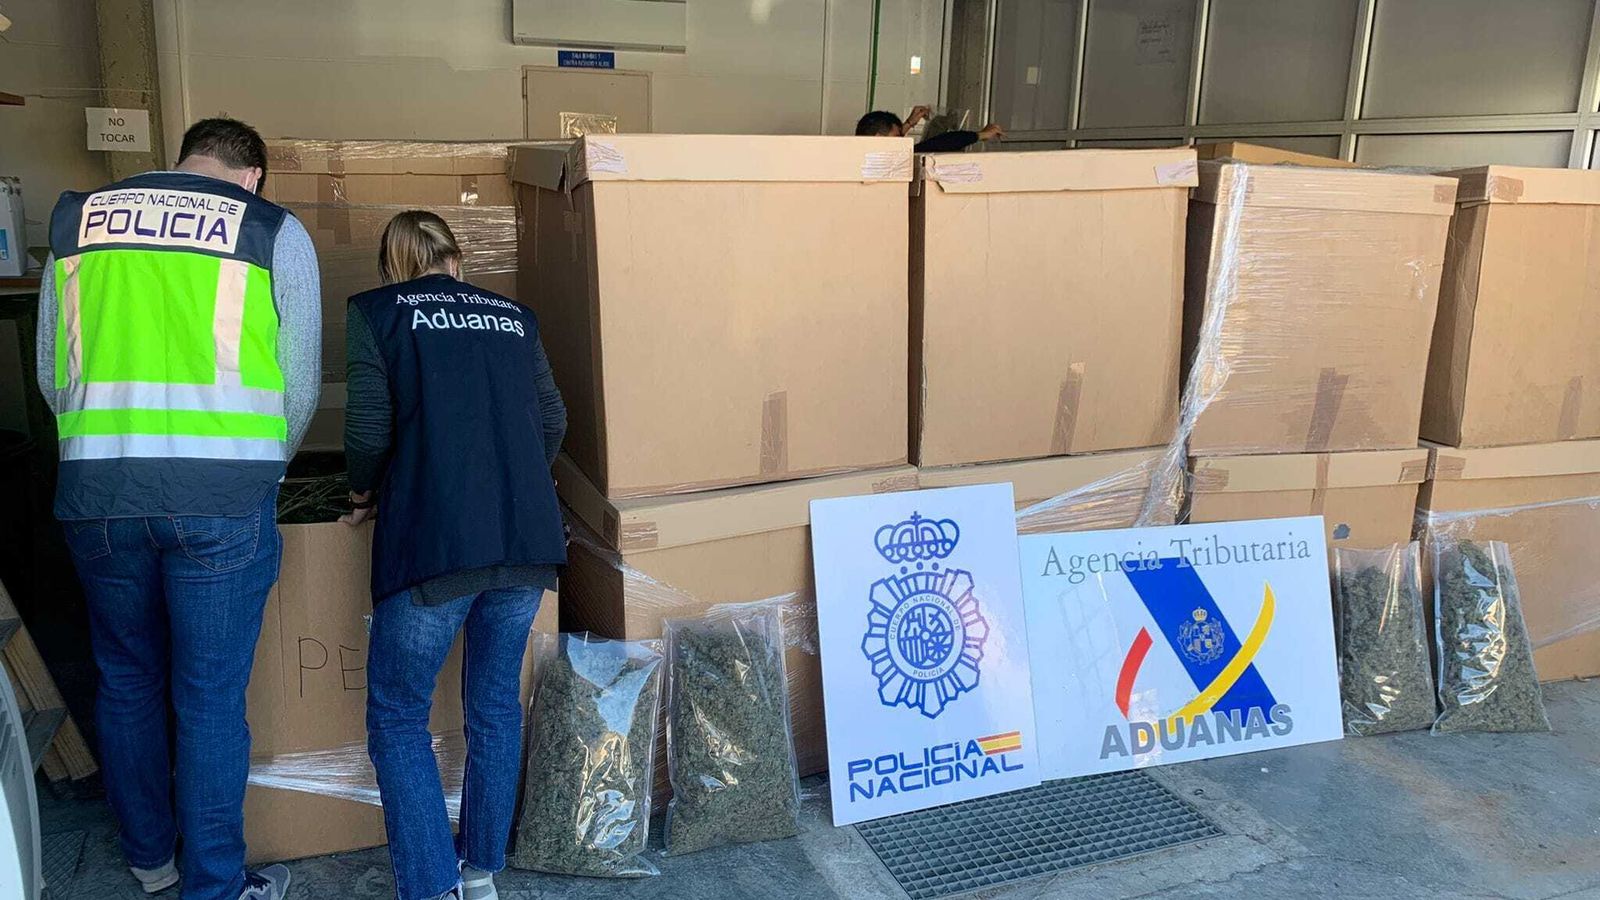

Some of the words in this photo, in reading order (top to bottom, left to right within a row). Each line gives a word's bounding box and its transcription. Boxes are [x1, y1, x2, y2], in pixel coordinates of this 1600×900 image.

[108, 117, 125, 126] NO
[100, 133, 135, 143] TOCAR
[90, 193, 145, 207] CUERPO
[147, 194, 214, 211] NACIONAL
[218, 201, 239, 215] DE
[84, 209, 228, 245] POLICIA
[396, 292, 456, 306] Agencia
[412, 308, 525, 337] Aduanas
[1041, 541, 1163, 584] Agencia
[1170, 532, 1311, 569] Tributaria
[889, 602, 910, 640] CUERPO
[912, 595, 954, 616] NACIONAL
[953, 619, 960, 631] DE
[1100, 704, 1294, 760] ADUANAS
[850, 754, 1024, 803] NACIONAL
